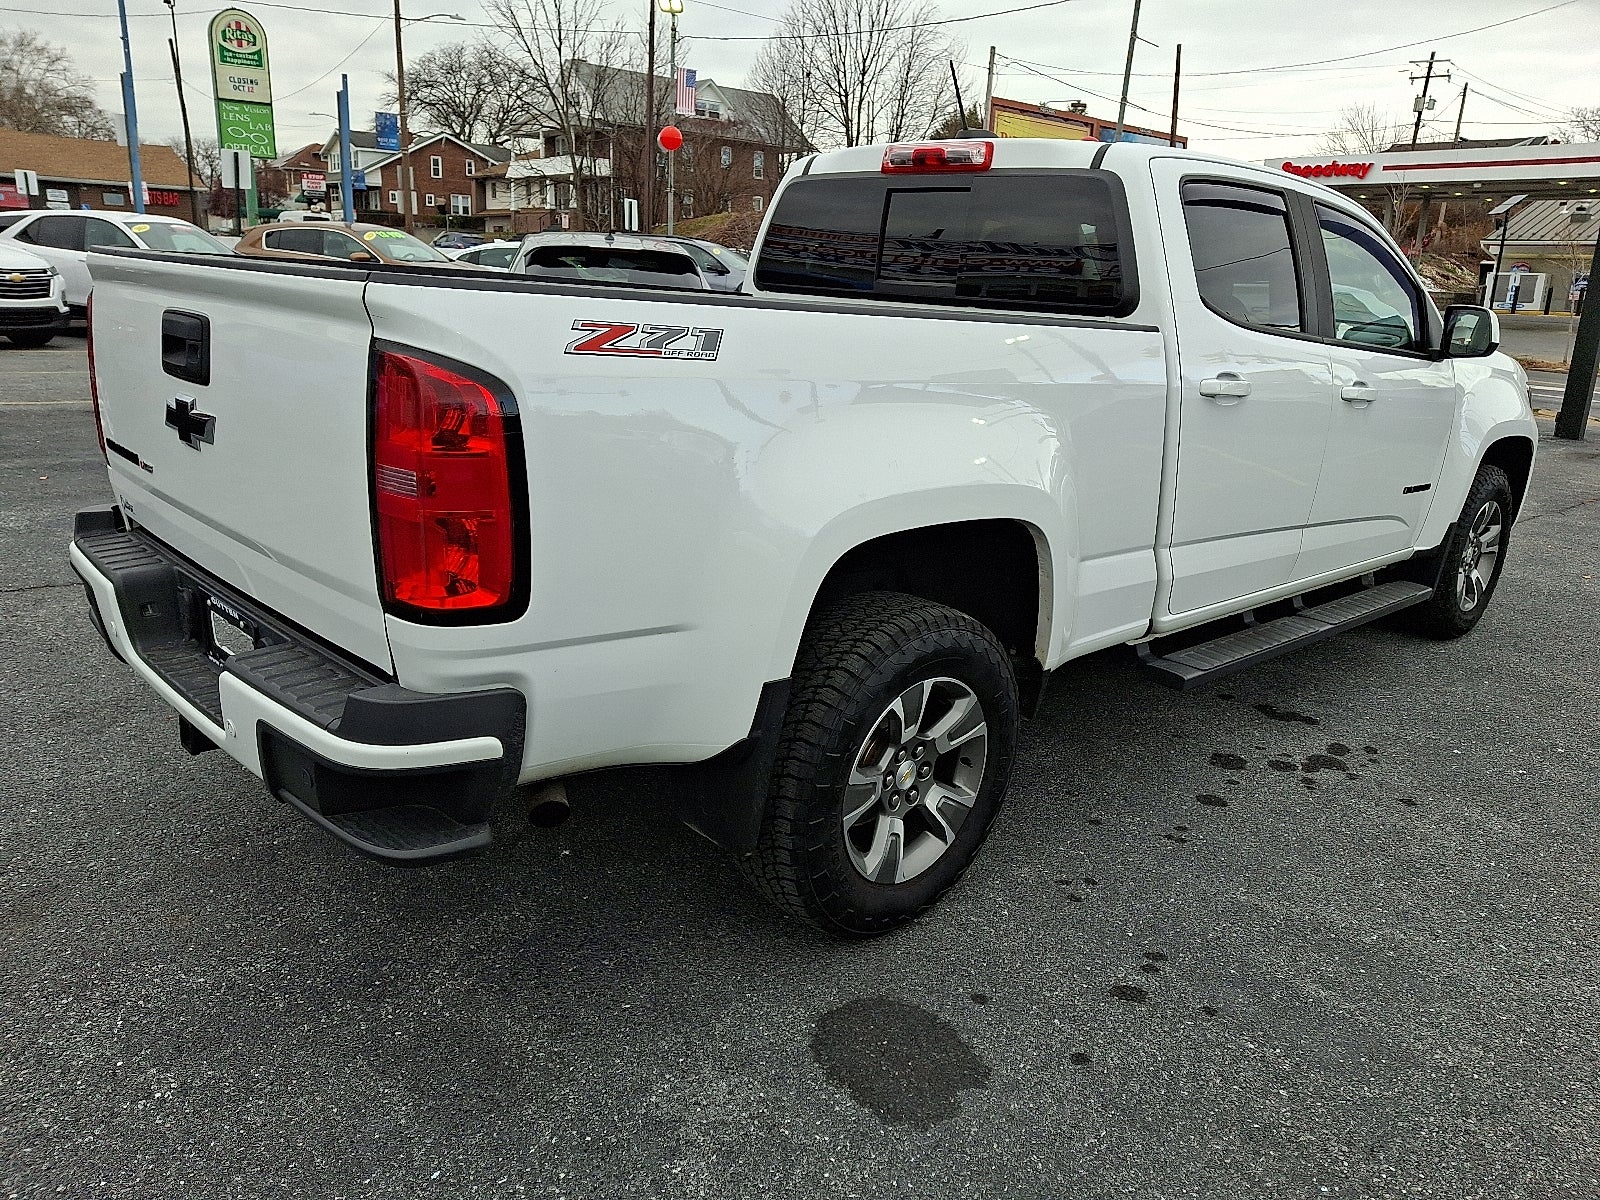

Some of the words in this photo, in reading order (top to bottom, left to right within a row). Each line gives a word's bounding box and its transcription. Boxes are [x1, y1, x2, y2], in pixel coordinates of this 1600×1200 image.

[225, 27, 254, 43] Rita's
[229, 76, 259, 86] CLOSING
[232, 84, 246, 92] OCT
[248, 86, 255, 94] 12
[222, 104, 240, 112] New
[243, 105, 270, 114] Vision
[223, 112, 250, 122] LENS
[250, 122, 272, 132] LAB
[224, 142, 274, 156] OPTICAL
[1282, 160, 1375, 180] Speedway
[163, 192, 180, 206] BAR
[563, 319, 724, 361] Z71
